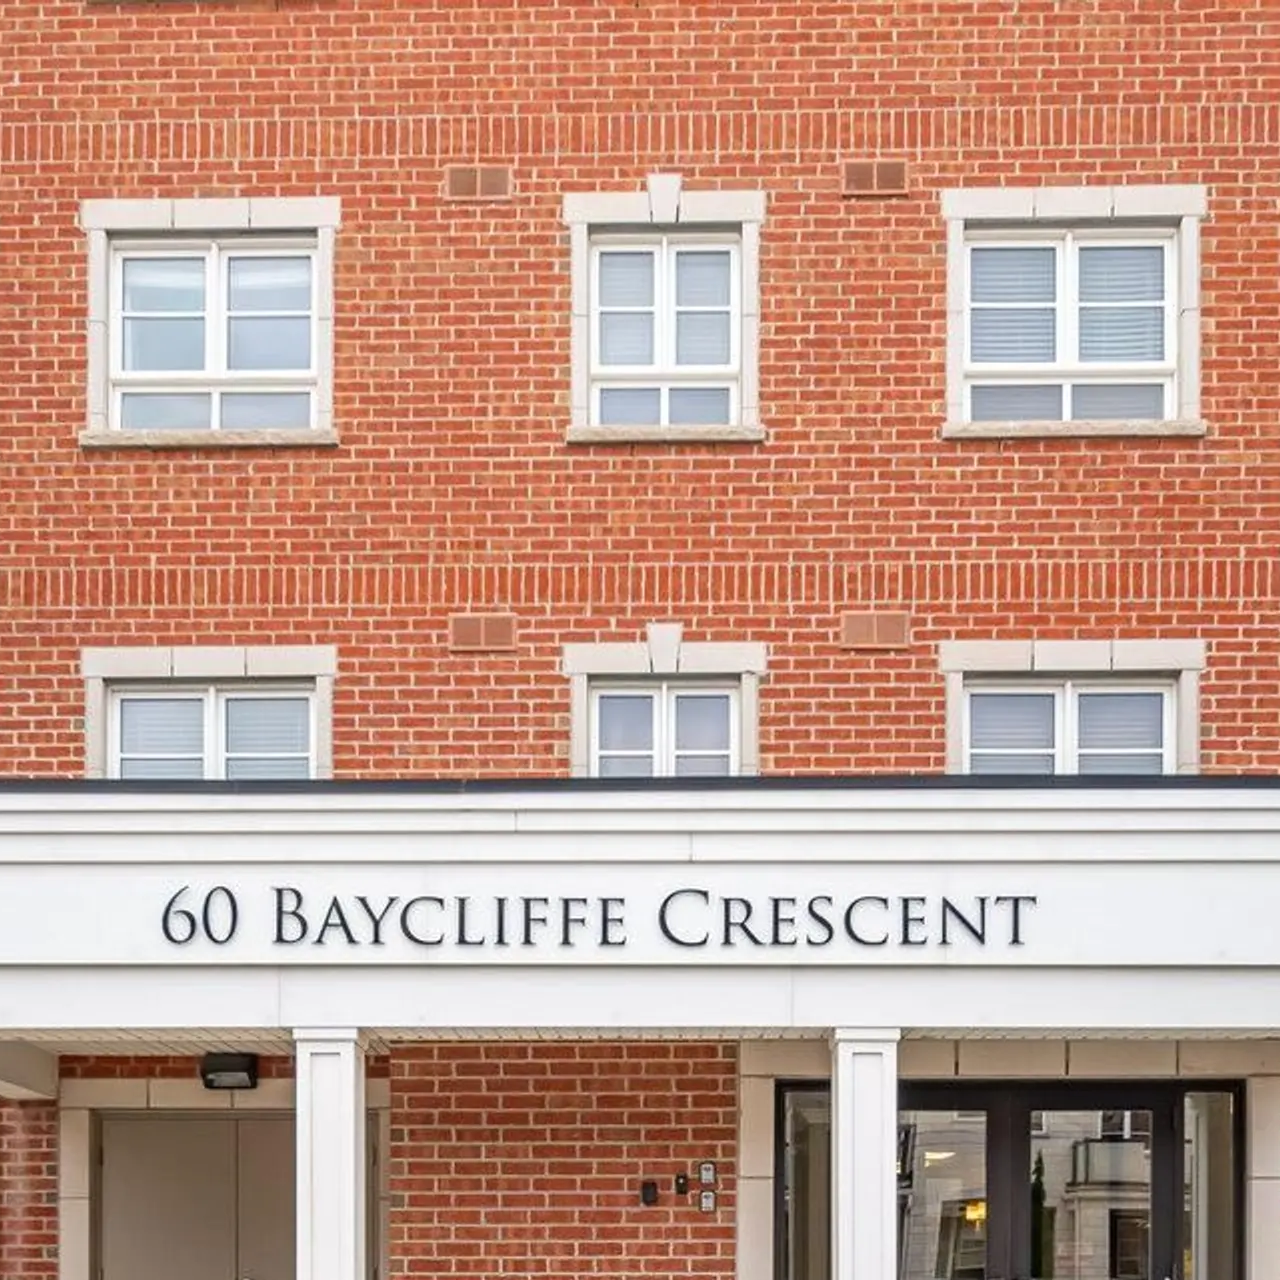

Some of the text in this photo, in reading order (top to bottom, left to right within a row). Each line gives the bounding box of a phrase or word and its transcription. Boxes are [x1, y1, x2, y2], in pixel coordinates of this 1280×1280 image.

[162, 887, 1037, 947] 60 BAYCLIFFE CRESCENT
